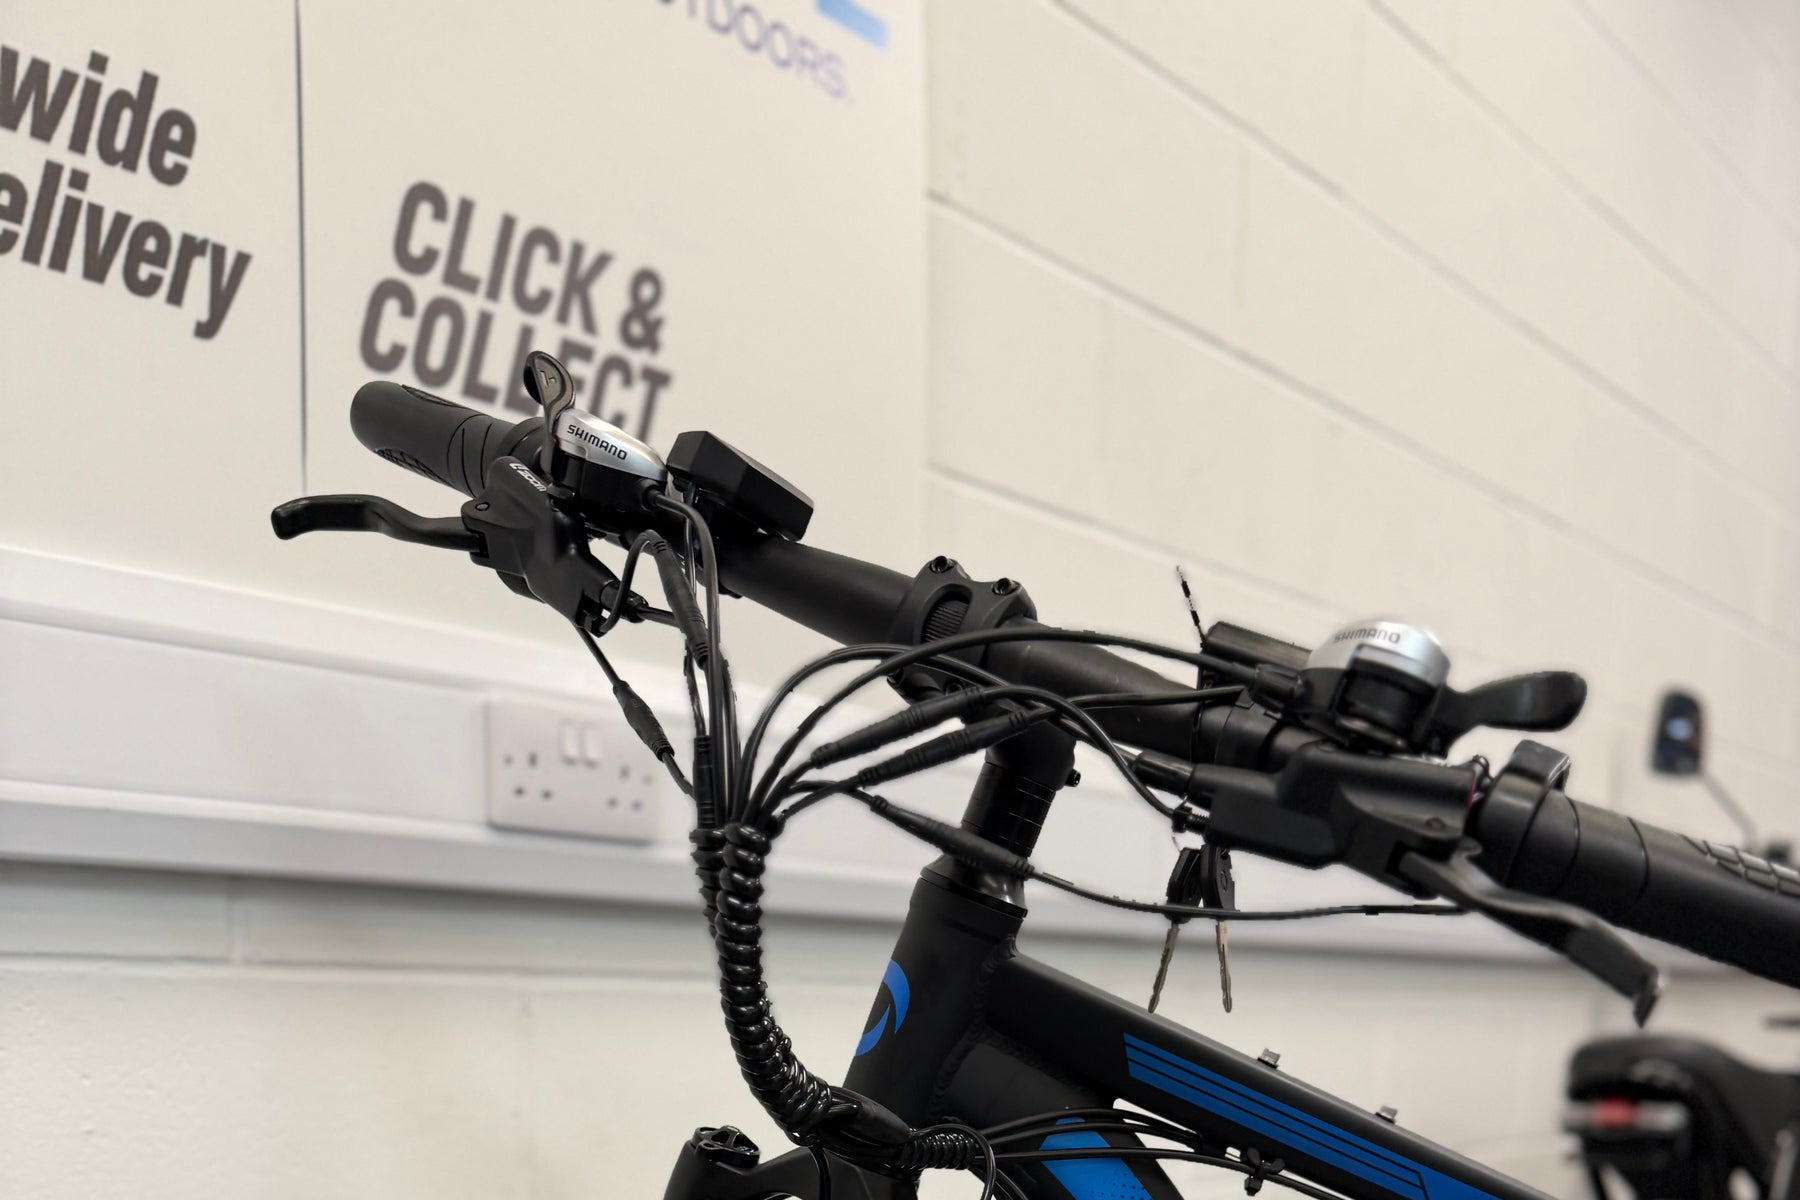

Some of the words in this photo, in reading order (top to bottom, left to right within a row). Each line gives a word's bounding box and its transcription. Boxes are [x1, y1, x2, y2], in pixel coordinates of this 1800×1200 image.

[0, 45, 196, 187] wide
[393, 181, 613, 339] CLICK
[620, 266, 665, 355] &
[567, 424, 628, 461] SHIMANO
[1333, 628, 1401, 644] SHIMANO
